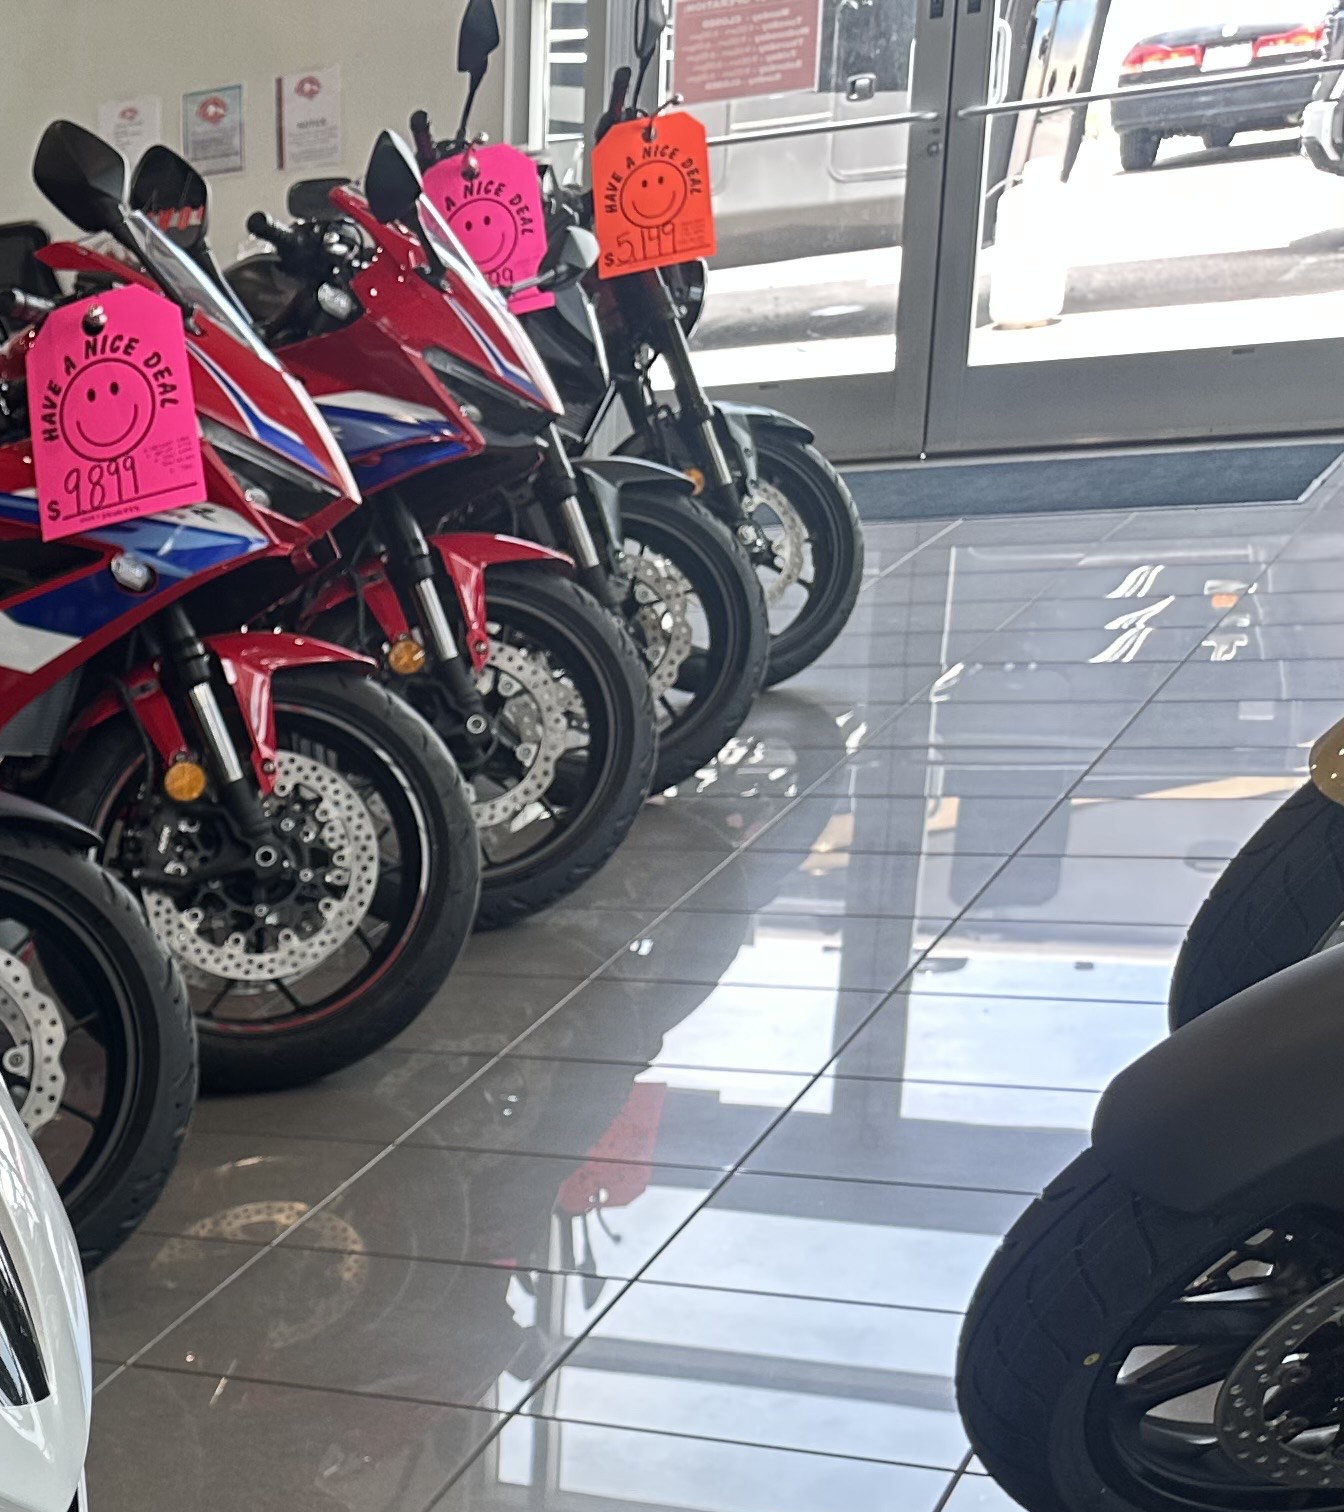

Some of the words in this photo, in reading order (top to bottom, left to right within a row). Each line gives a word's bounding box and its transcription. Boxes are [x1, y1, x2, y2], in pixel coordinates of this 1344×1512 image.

[444, 196, 456, 212] A
[464, 180, 506, 199] NICE
[509, 193, 534, 236] DEAL
[604, 172, 623, 214] HAVE
[626, 156, 635, 170] A
[642, 145, 679, 160] NICE
[681, 158, 701, 195] DEAL
[41, 380, 62, 442] HAVE
[64, 355, 77, 376] A
[84, 334, 139, 360] NICE
[143, 351, 179, 409] DEAL
